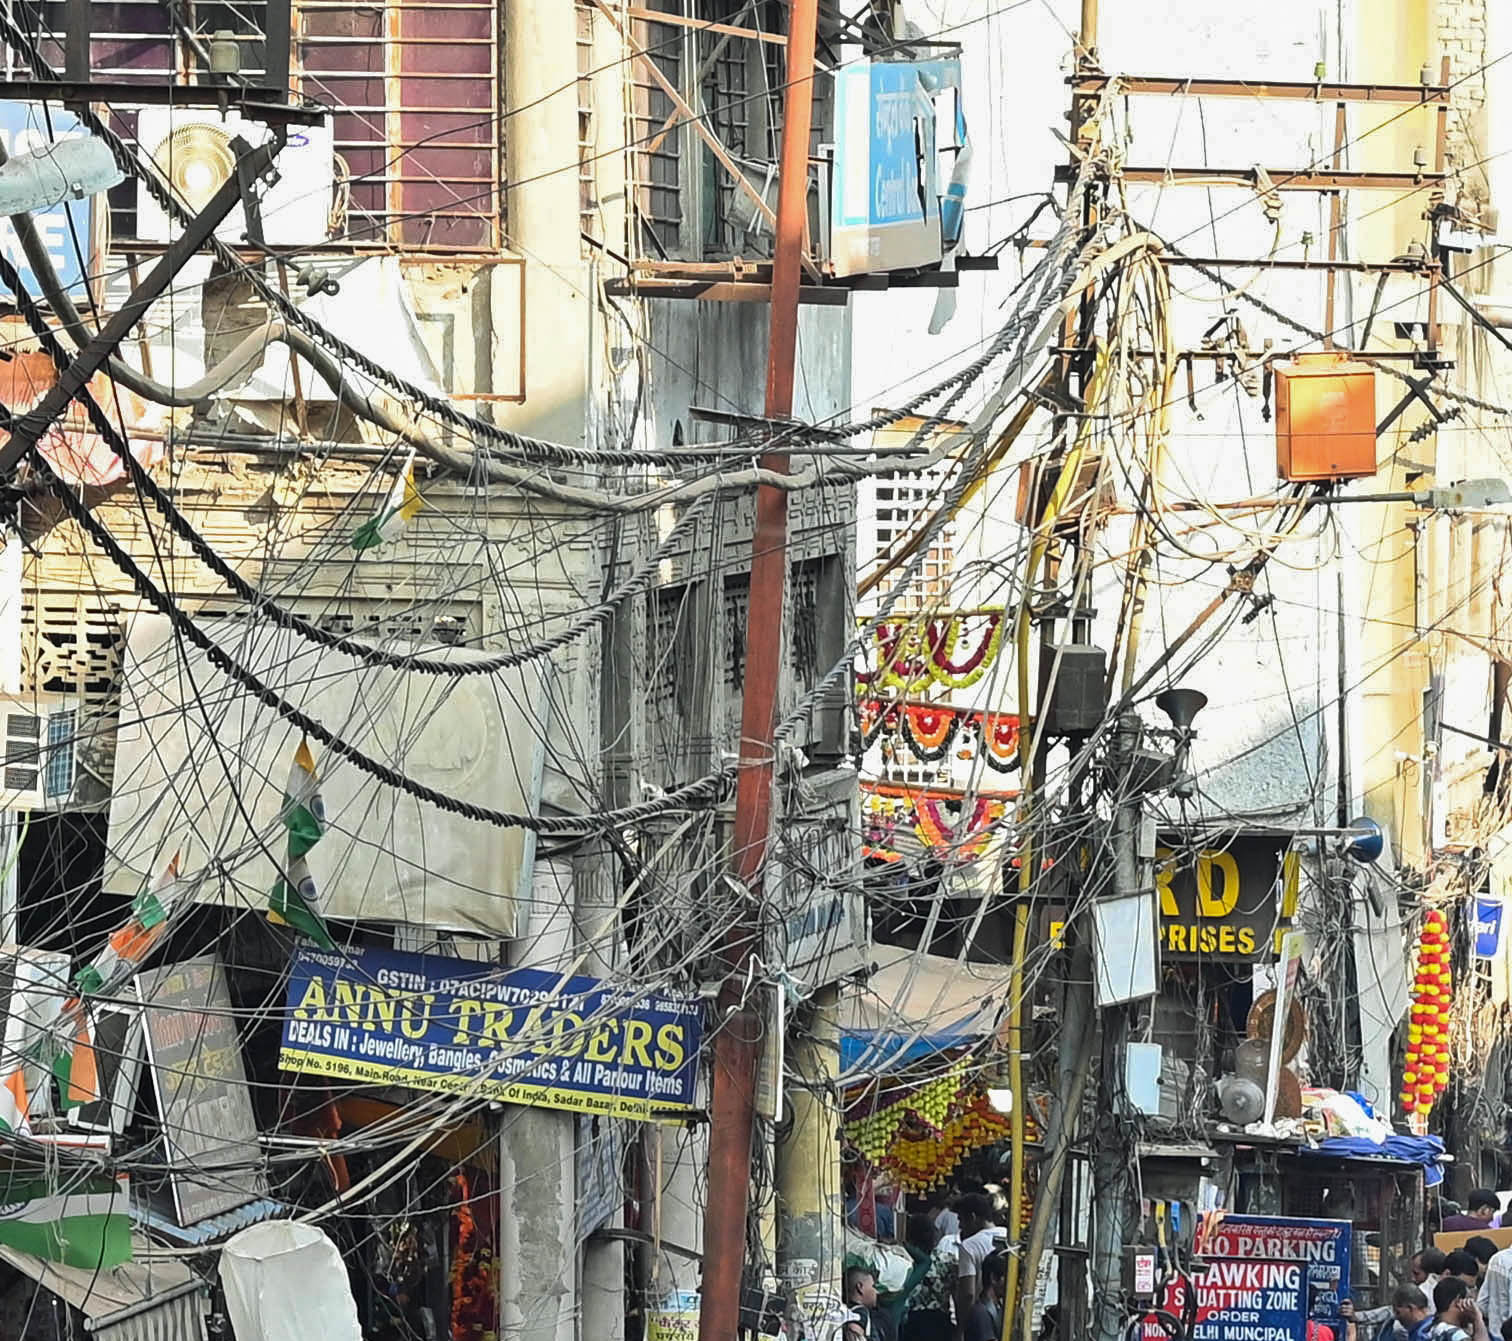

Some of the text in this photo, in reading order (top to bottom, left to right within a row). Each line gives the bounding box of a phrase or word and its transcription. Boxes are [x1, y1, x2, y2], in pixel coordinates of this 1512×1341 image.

[376, 968, 426, 990] GSTIN
[294, 975, 435, 1040] ANNU
[448, 998, 685, 1072] TRADERS
[288, 1020, 332, 1048] DEALS
[334, 1027, 349, 1051] IN
[359, 1031, 425, 1068] Jewellery,
[560, 1062, 570, 1082] &
[573, 1061, 591, 1086] All
[594, 1065, 643, 1091] Parlour
[644, 1069, 683, 1096] Items
[306, 1056, 323, 1070] No.
[508, 1085, 521, 1099] Of
[554, 1092, 584, 1107] Sadar
[1239, 1236, 1336, 1263] PARKING
[1191, 1261, 1301, 1291] HAWKING
[1174, 1287, 1299, 1311] SUATTING ZONE
[1207, 1312, 1260, 1324] ORDER
[1187, 1323, 1219, 1341] ELHI
